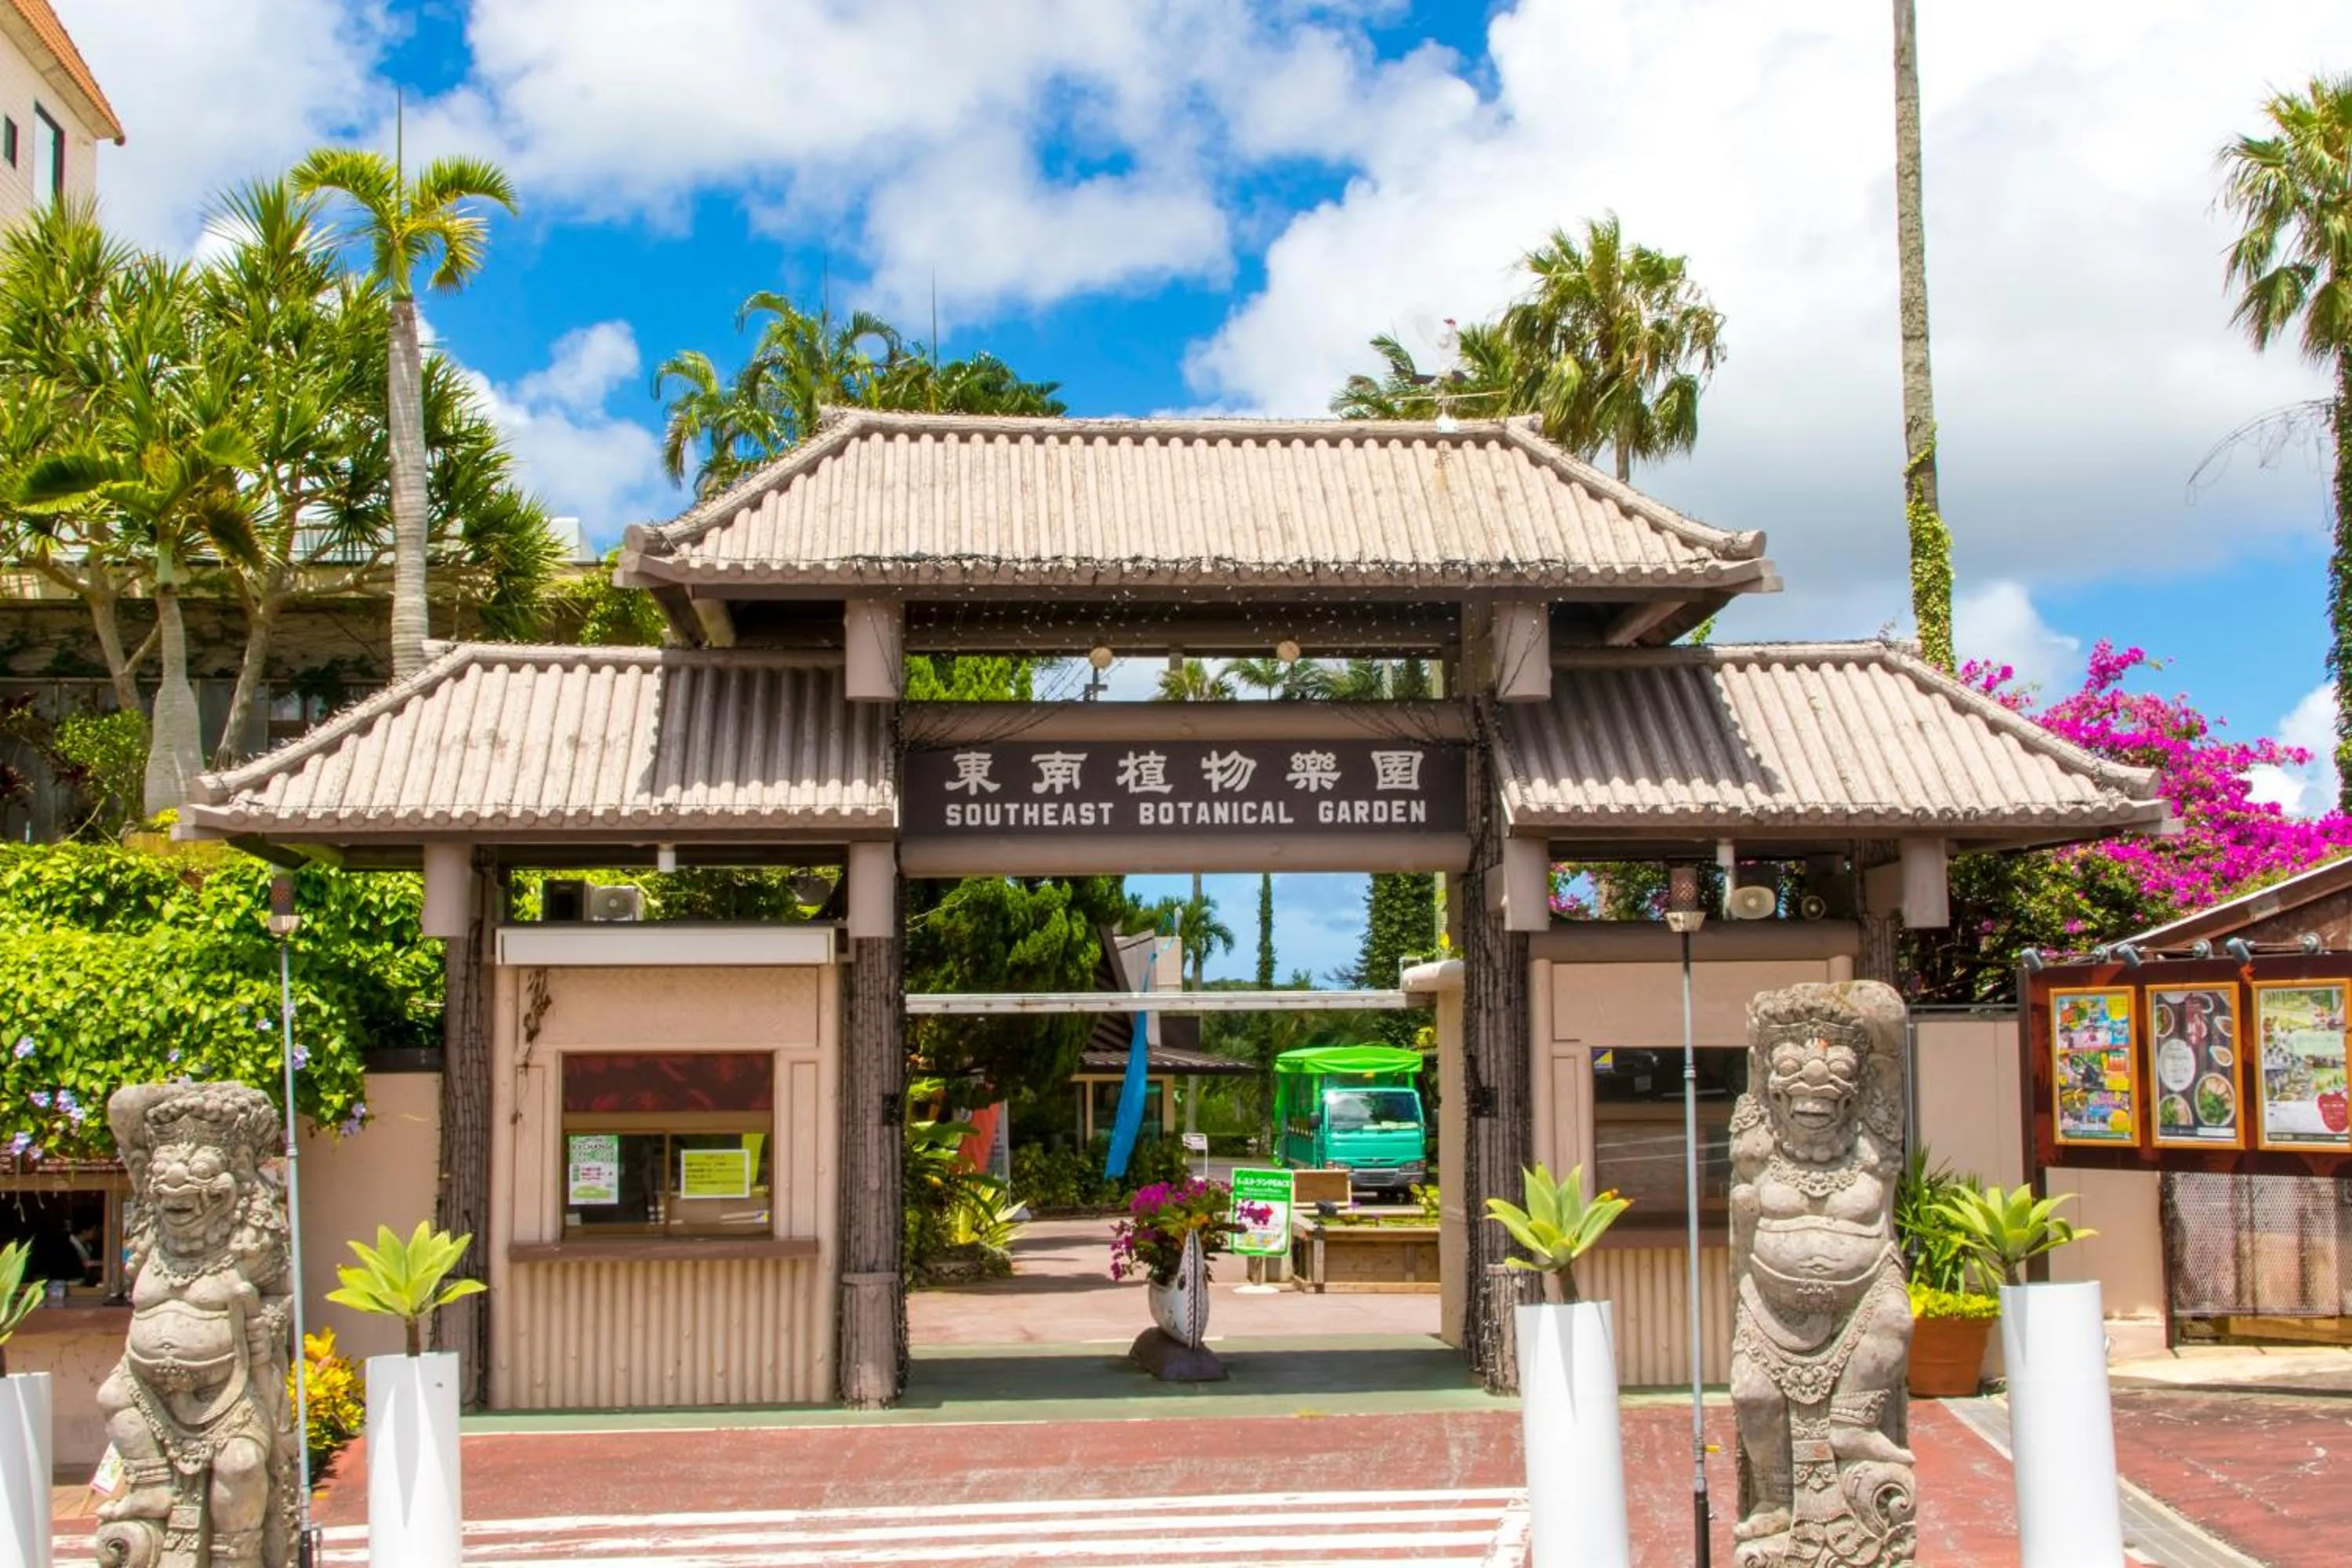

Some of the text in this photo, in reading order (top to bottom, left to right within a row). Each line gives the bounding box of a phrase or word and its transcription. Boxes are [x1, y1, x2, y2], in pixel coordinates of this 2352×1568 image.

[946, 800, 1425, 826] SOUTHEAST BOTANICAL GARDEN
